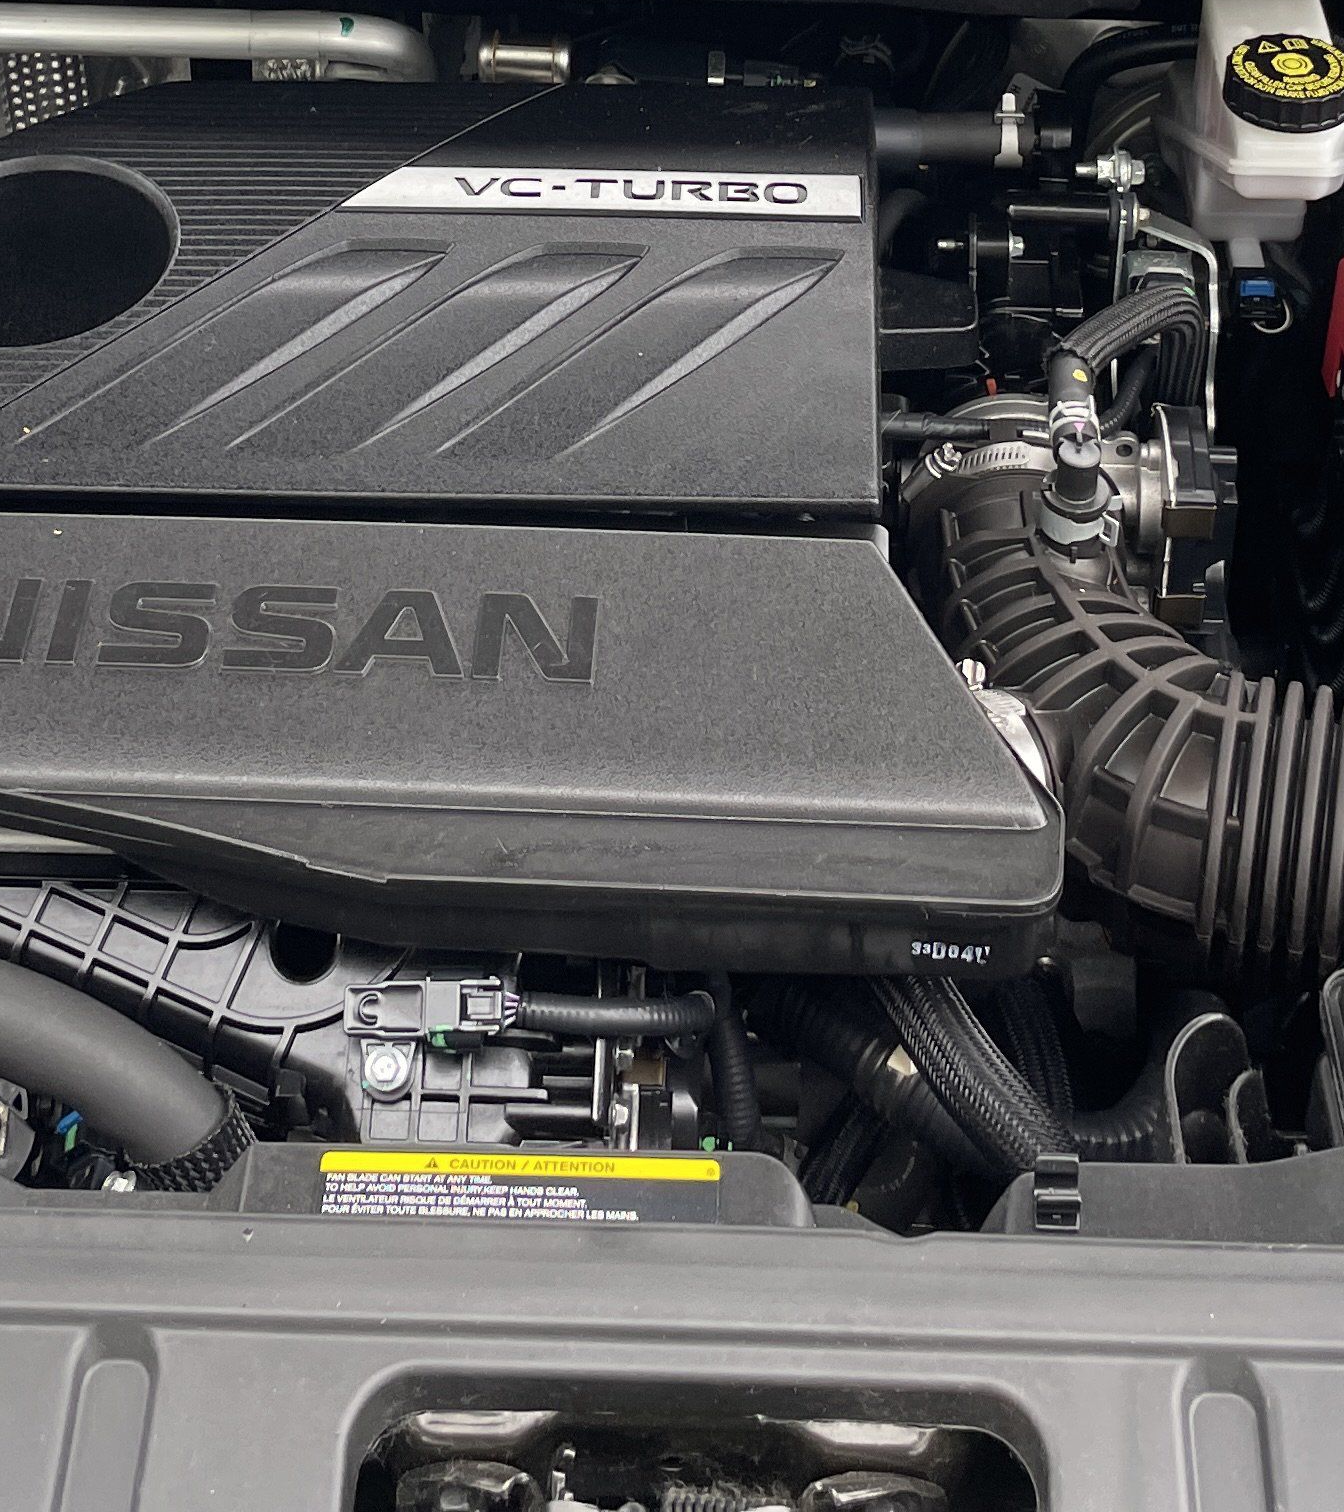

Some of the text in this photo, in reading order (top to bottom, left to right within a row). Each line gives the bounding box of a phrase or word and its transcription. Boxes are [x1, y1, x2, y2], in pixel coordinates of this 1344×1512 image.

[454, 175, 809, 204] VC-TURBO
[449, 1158, 516, 1171] CAUTION
[533, 1160, 616, 1174] ATTENTION
